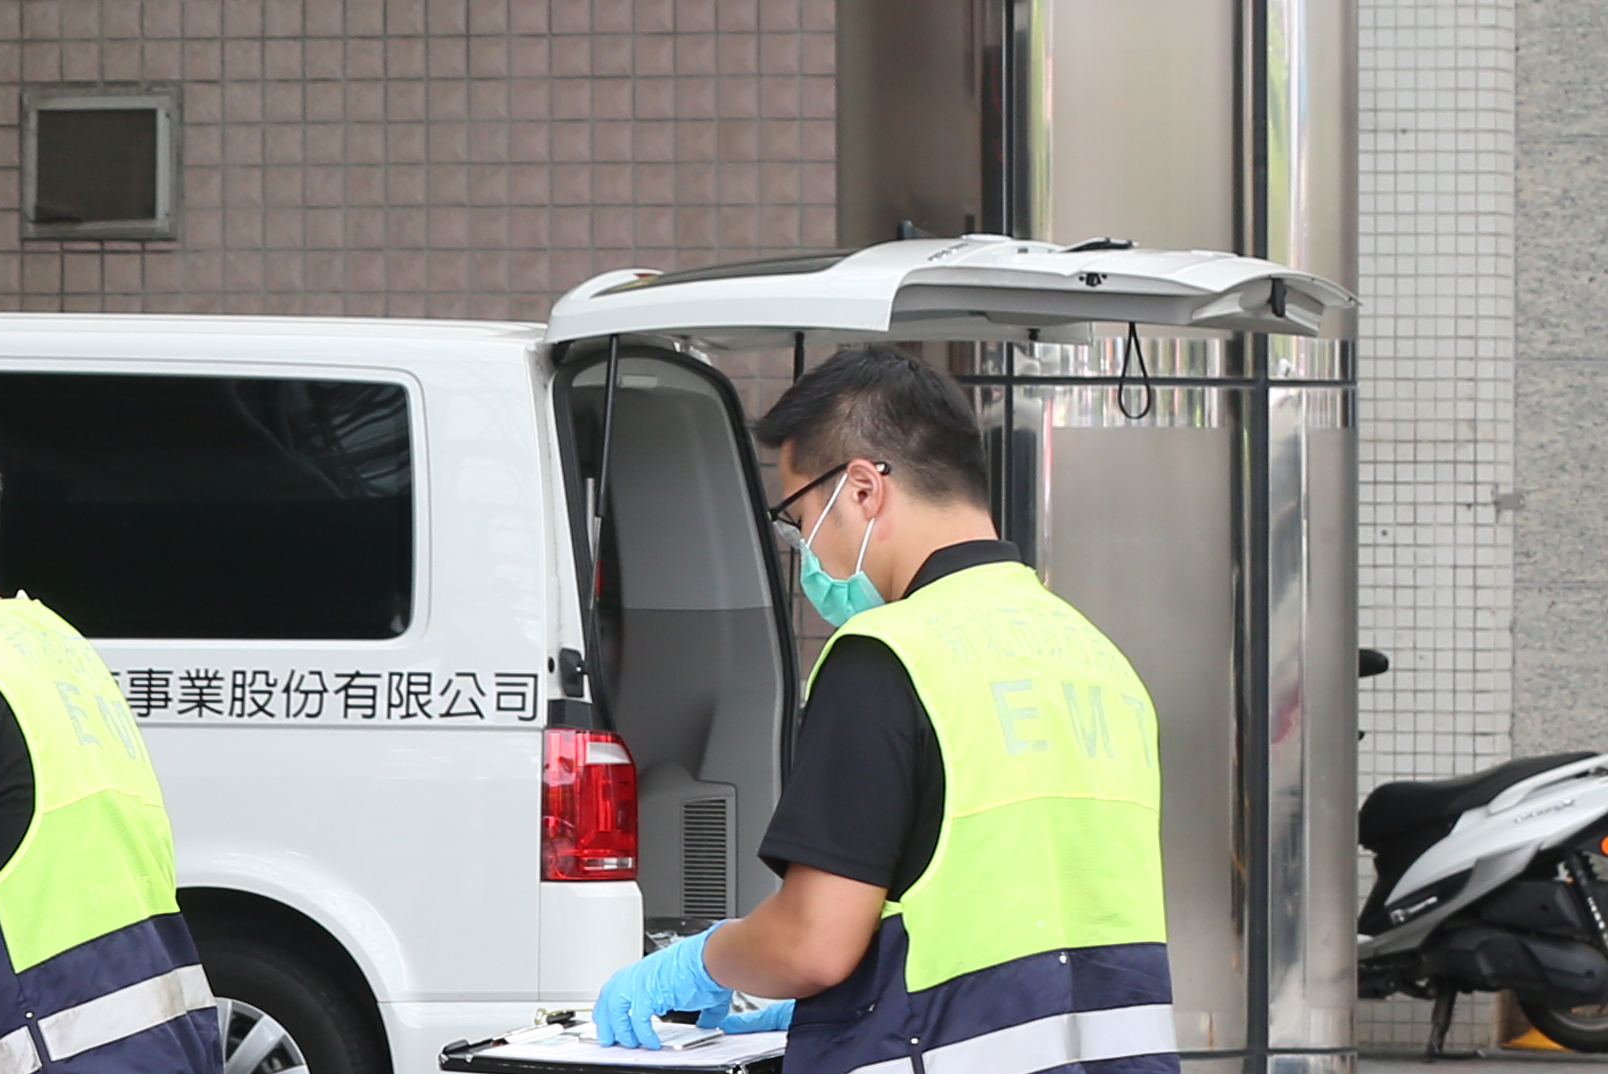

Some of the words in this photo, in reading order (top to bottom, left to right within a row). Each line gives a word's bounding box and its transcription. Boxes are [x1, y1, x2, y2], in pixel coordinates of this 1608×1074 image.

[110, 667, 541, 722] 事業股份有限公司
